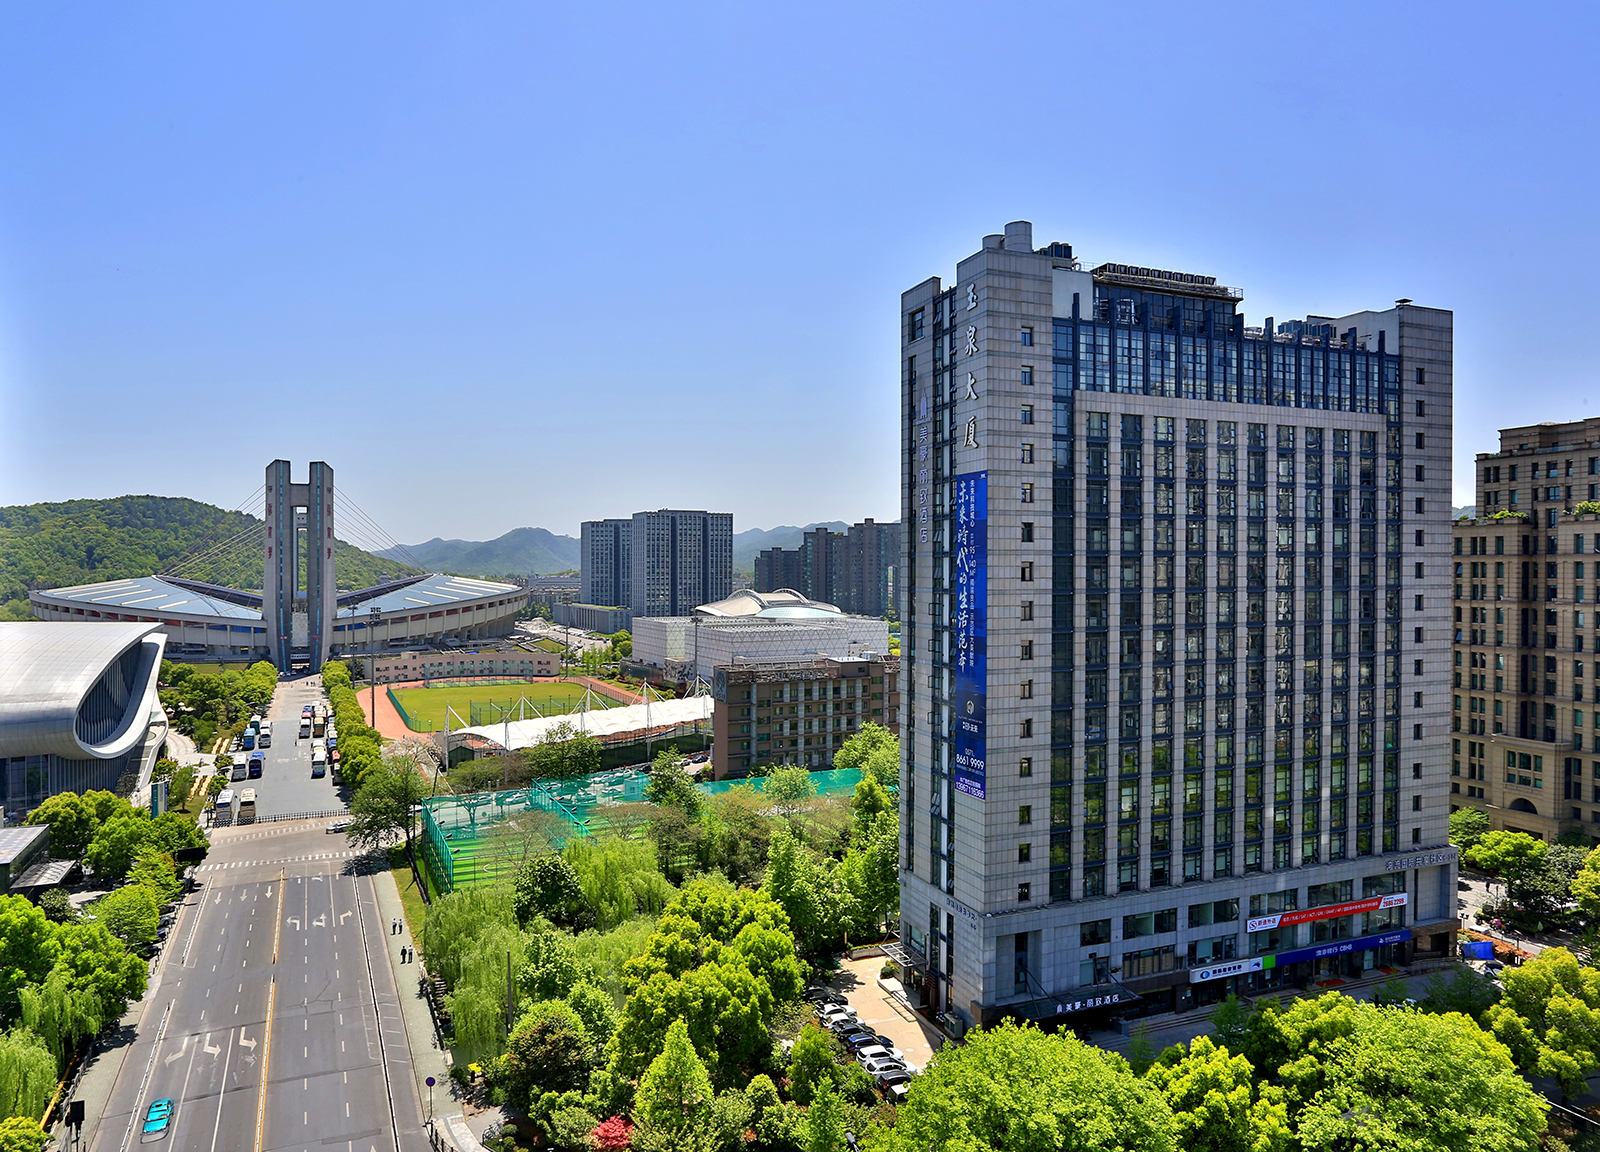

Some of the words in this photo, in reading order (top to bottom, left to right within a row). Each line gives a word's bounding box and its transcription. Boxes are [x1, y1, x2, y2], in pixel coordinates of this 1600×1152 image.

[964, 283, 979, 449] 玉泉大厦
[956, 753, 969, 765] 8661
[970, 757, 984, 770] 9999
